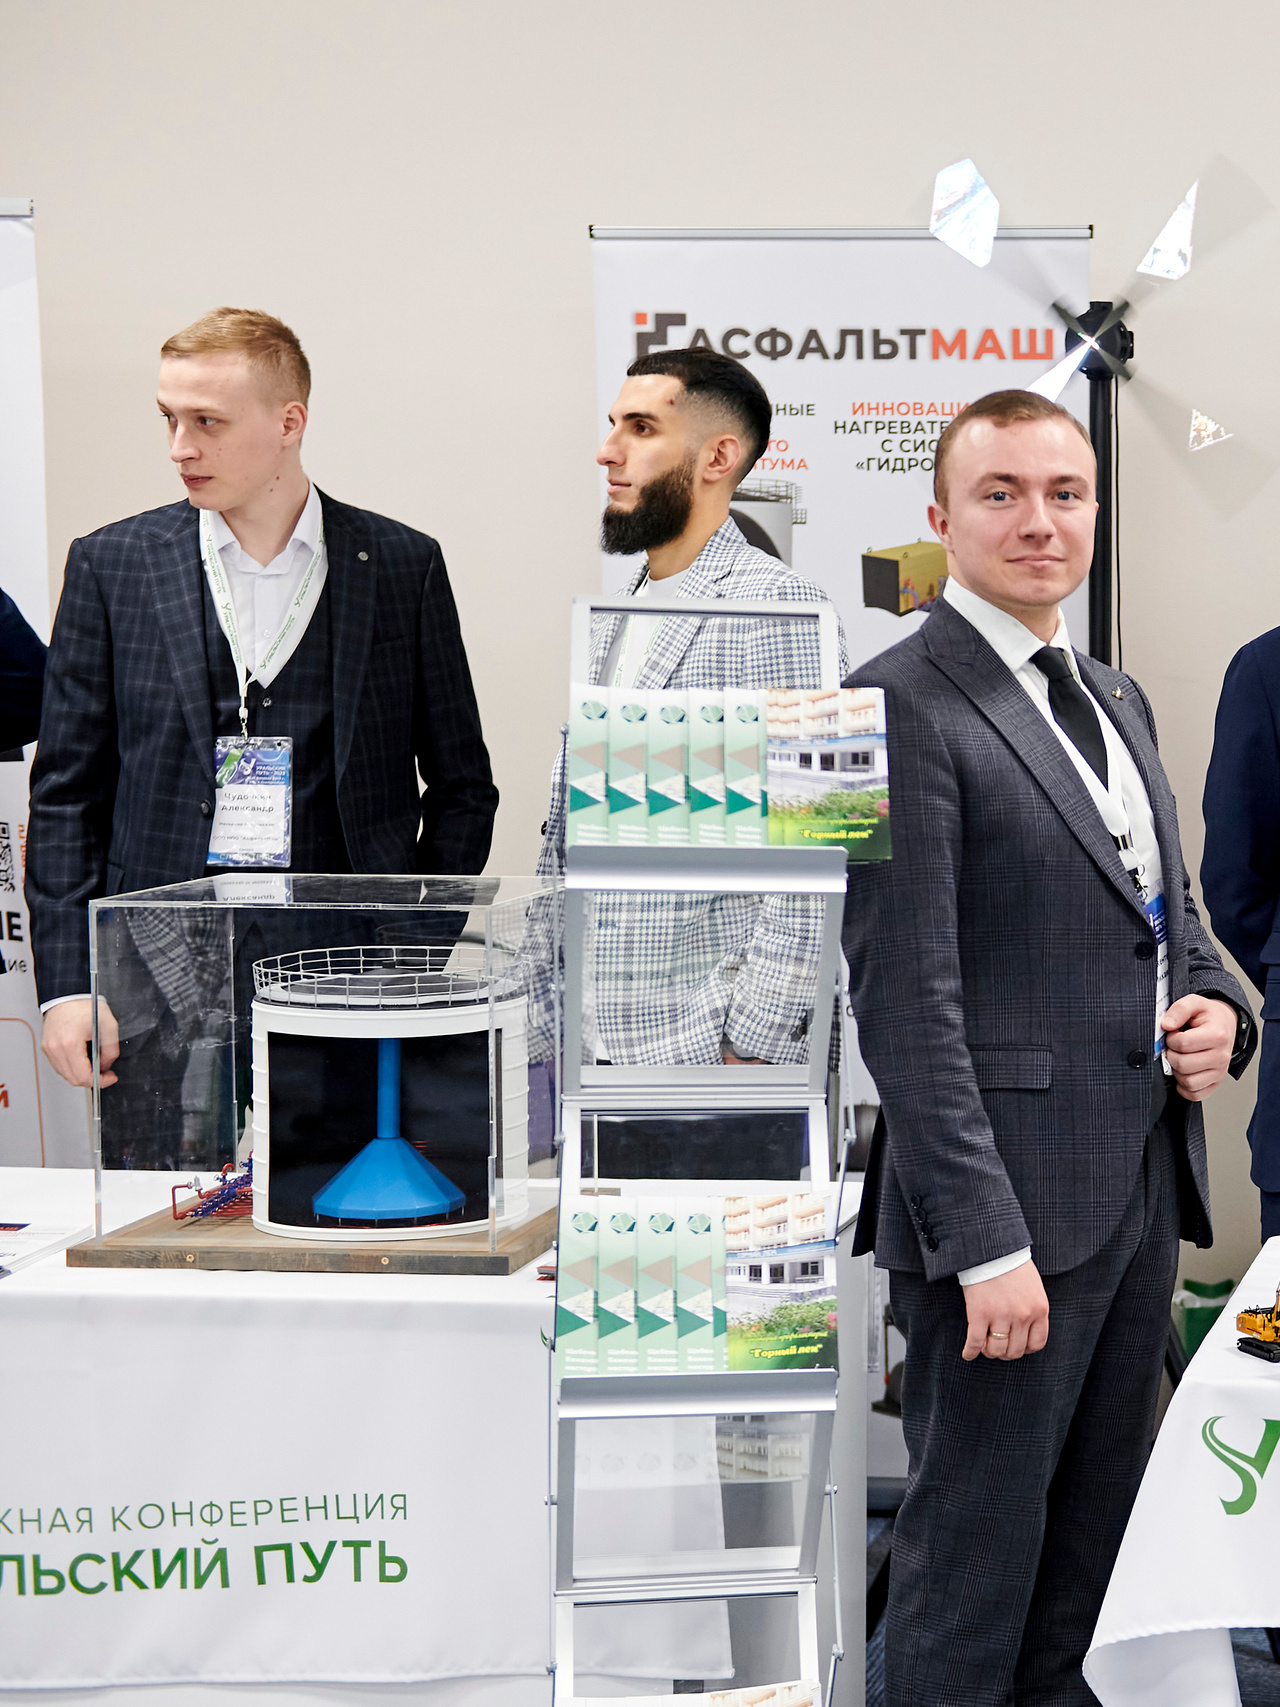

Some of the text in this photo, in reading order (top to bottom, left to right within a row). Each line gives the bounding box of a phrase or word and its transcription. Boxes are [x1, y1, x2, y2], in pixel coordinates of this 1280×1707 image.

[690, 327, 1054, 361] АСФАЛЬТМАШ
[852, 402, 970, 418] ИННОВАЦИ
[834, 420, 950, 434] НАГРЕВАТЕ
[881, 439, 937, 453] С СИС
[855, 458, 935, 473] «ГИДРО
[111, 1493, 408, 1532] КОНФЕРЕНЦИЯ
[0, 1537, 408, 1597] ЛЬСКИЙ ПУТЬ
